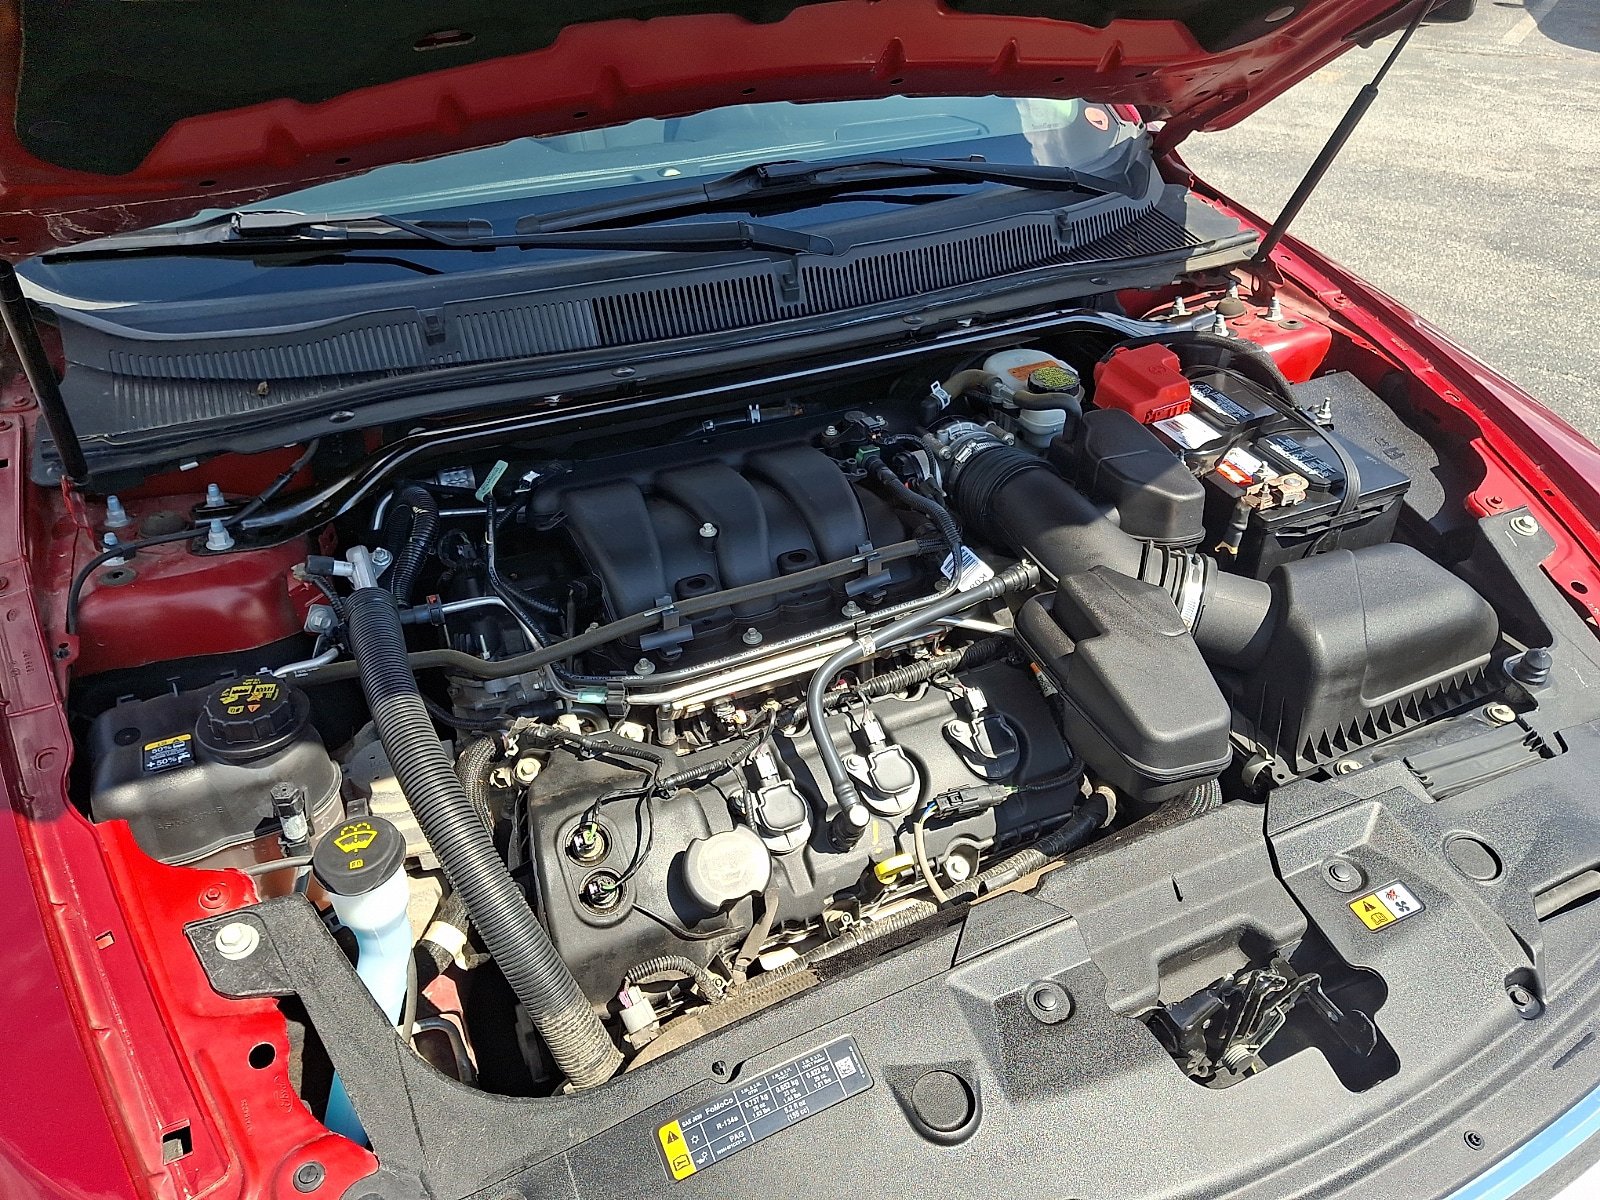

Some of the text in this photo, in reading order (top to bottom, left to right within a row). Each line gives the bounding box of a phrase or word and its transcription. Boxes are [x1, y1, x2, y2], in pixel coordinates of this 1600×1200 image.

[820, 1064, 829, 1074] kg
[790, 1078, 799, 1088] kg
[760, 1093, 769, 1103] kg
[704, 1096, 734, 1116] FoMoCo
[716, 1115, 739, 1131] R-134a
[729, 1130, 745, 1142] PAG
